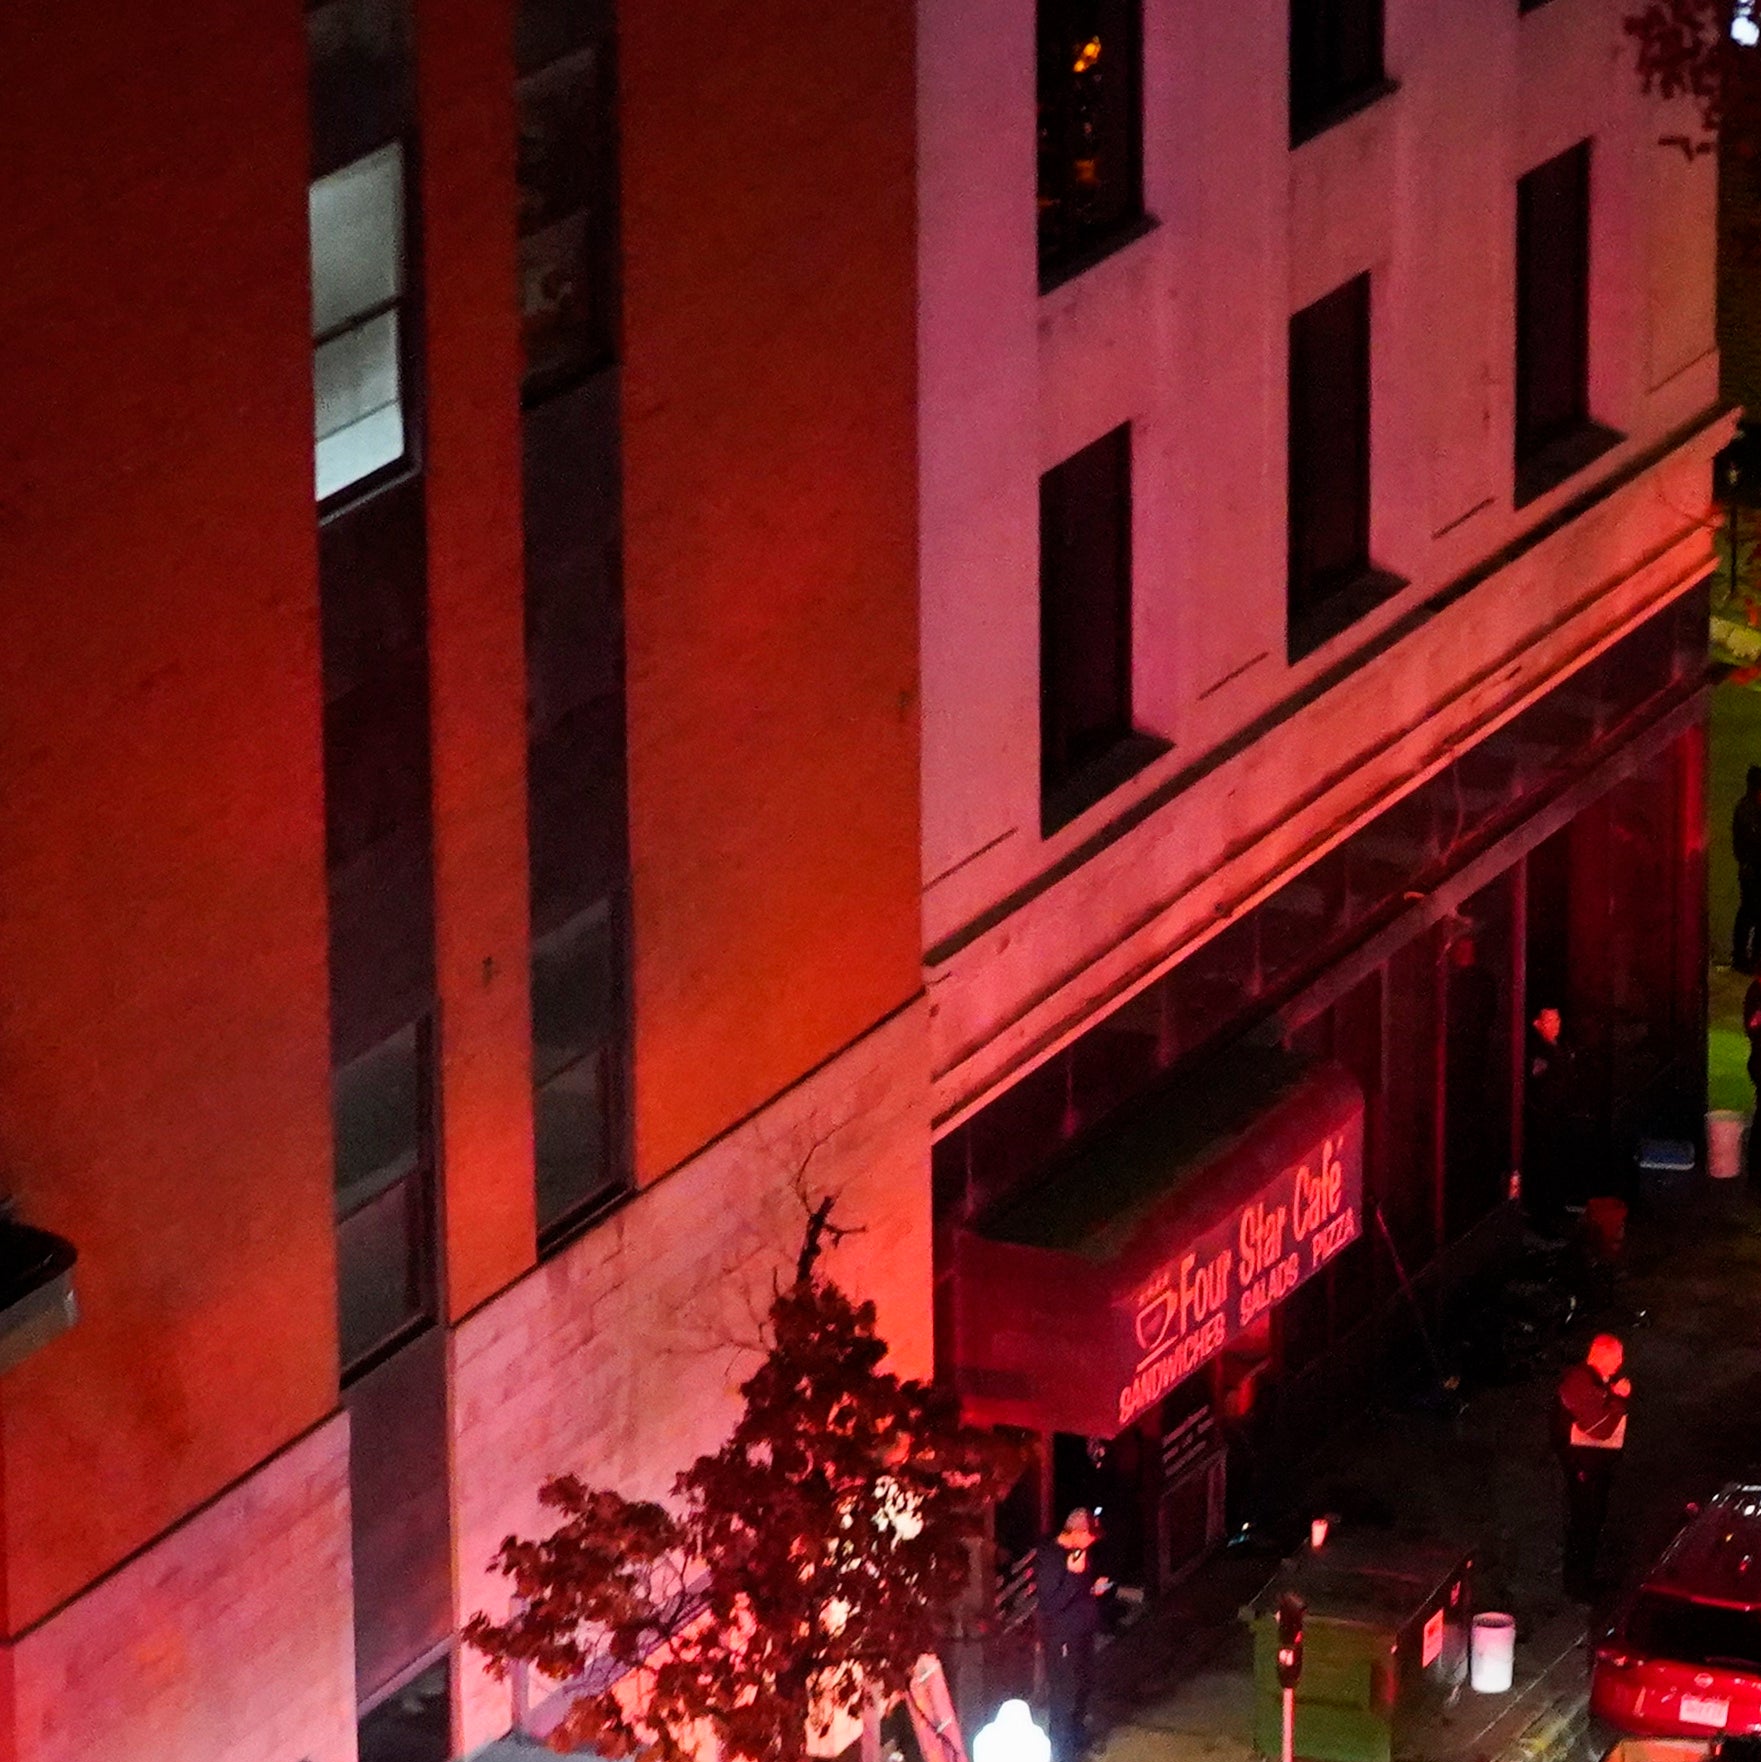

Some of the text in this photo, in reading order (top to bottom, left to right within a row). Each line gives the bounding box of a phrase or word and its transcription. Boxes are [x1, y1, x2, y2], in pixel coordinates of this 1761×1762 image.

[1118, 1206, 1356, 1424] SANDWICHES SALADS PIZZA
[1179, 1250, 1232, 1335] Four
[1239, 1202, 1287, 1287] Star
